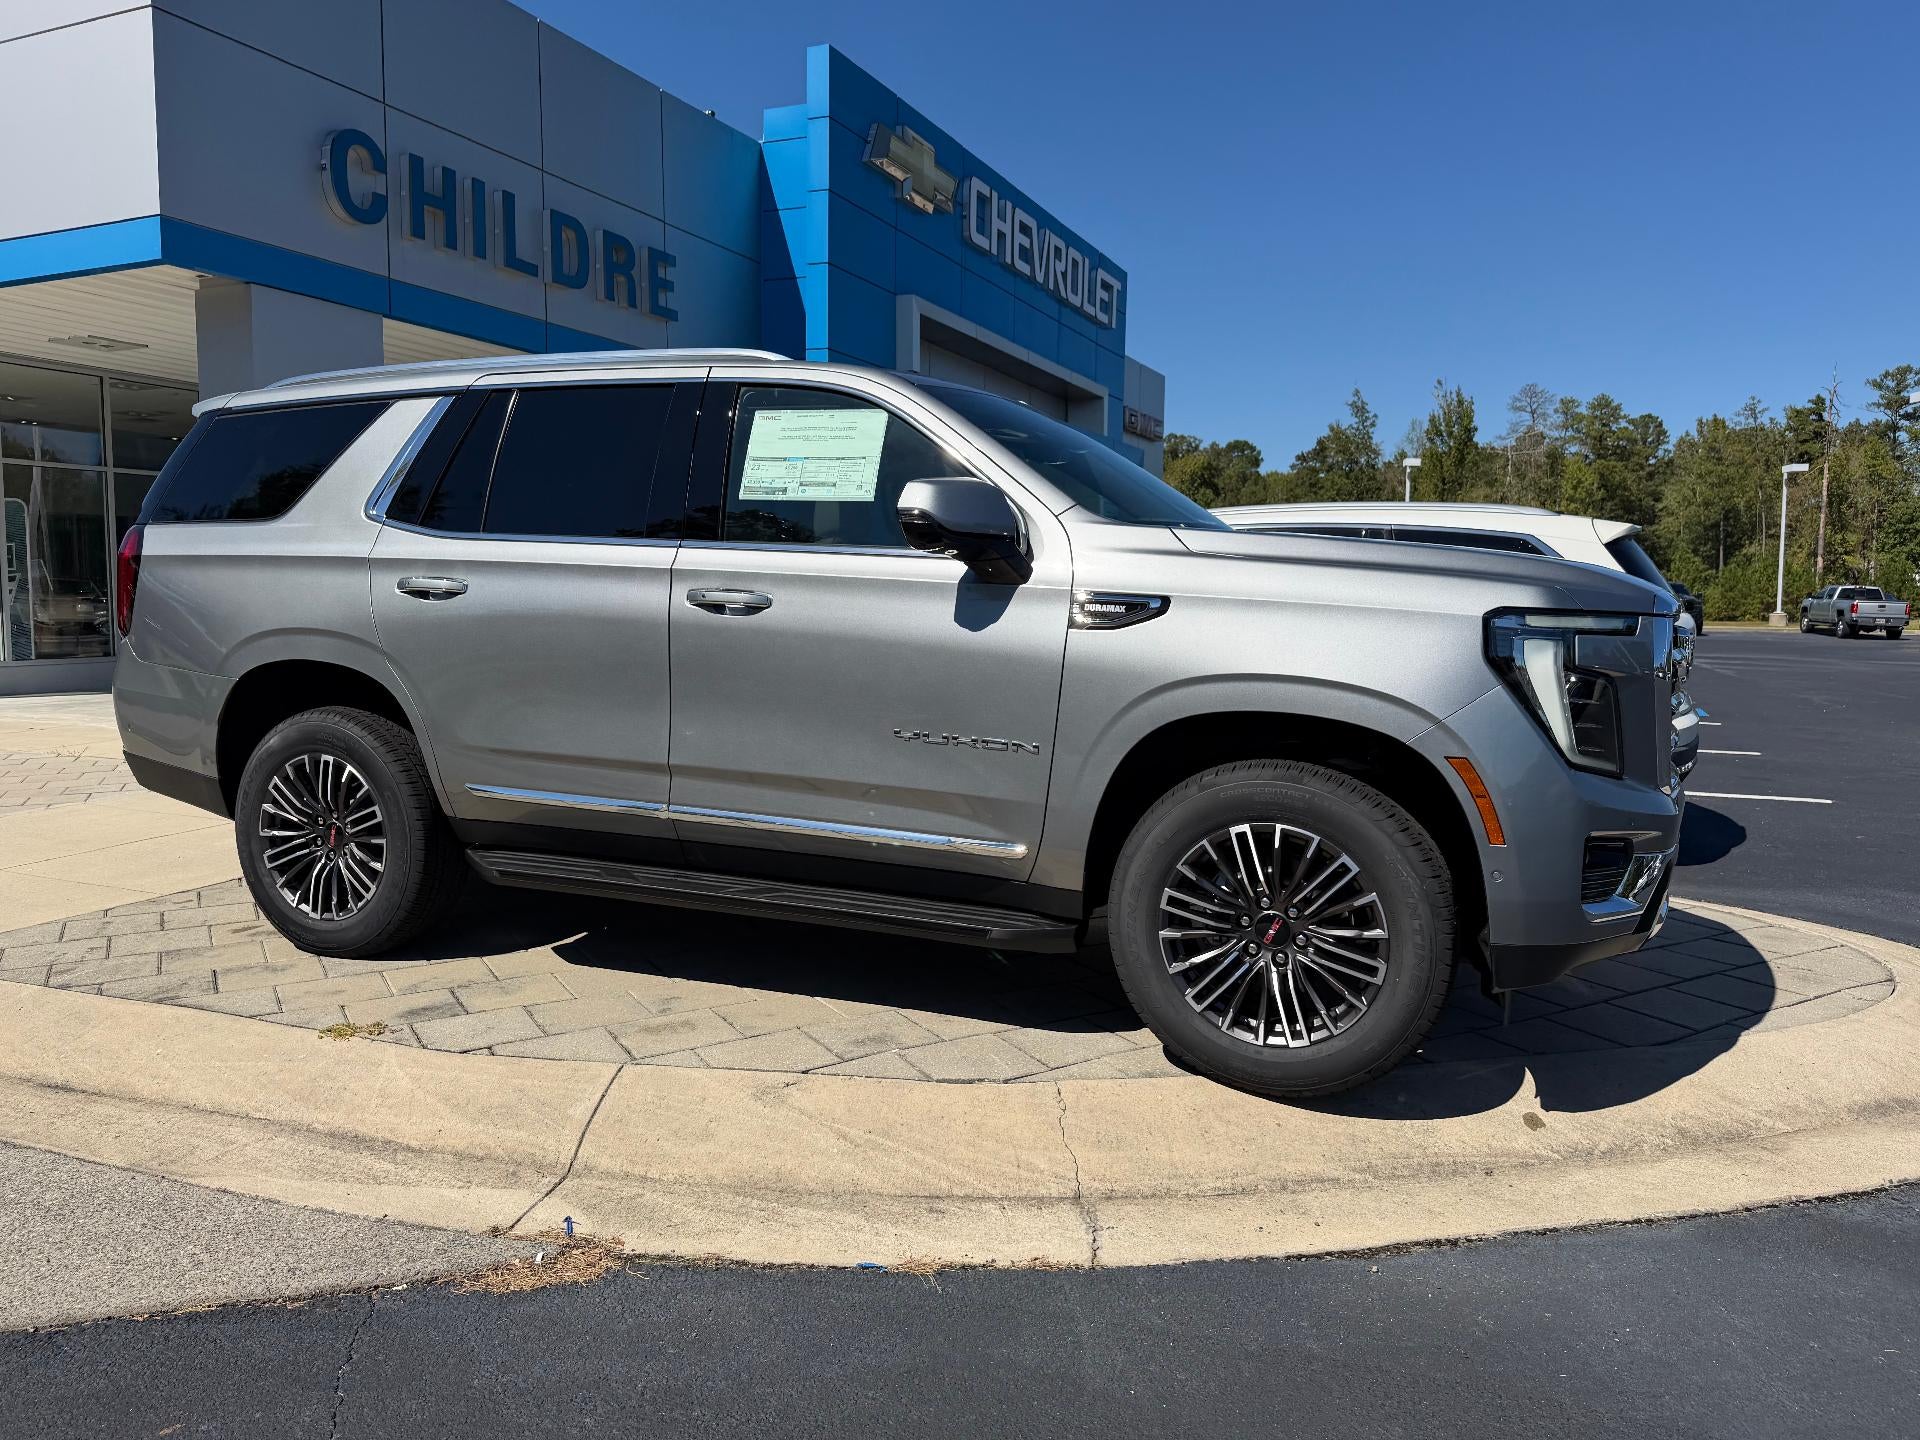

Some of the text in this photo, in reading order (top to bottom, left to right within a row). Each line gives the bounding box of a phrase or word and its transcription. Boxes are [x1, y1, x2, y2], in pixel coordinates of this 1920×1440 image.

[322, 128, 679, 322] CHILDRE
[965, 175, 1122, 330] CHEVROLET
[1083, 603, 1127, 613] DURAMAX
[893, 728, 1040, 755] YUKON
[1263, 917, 1283, 945] GMC
